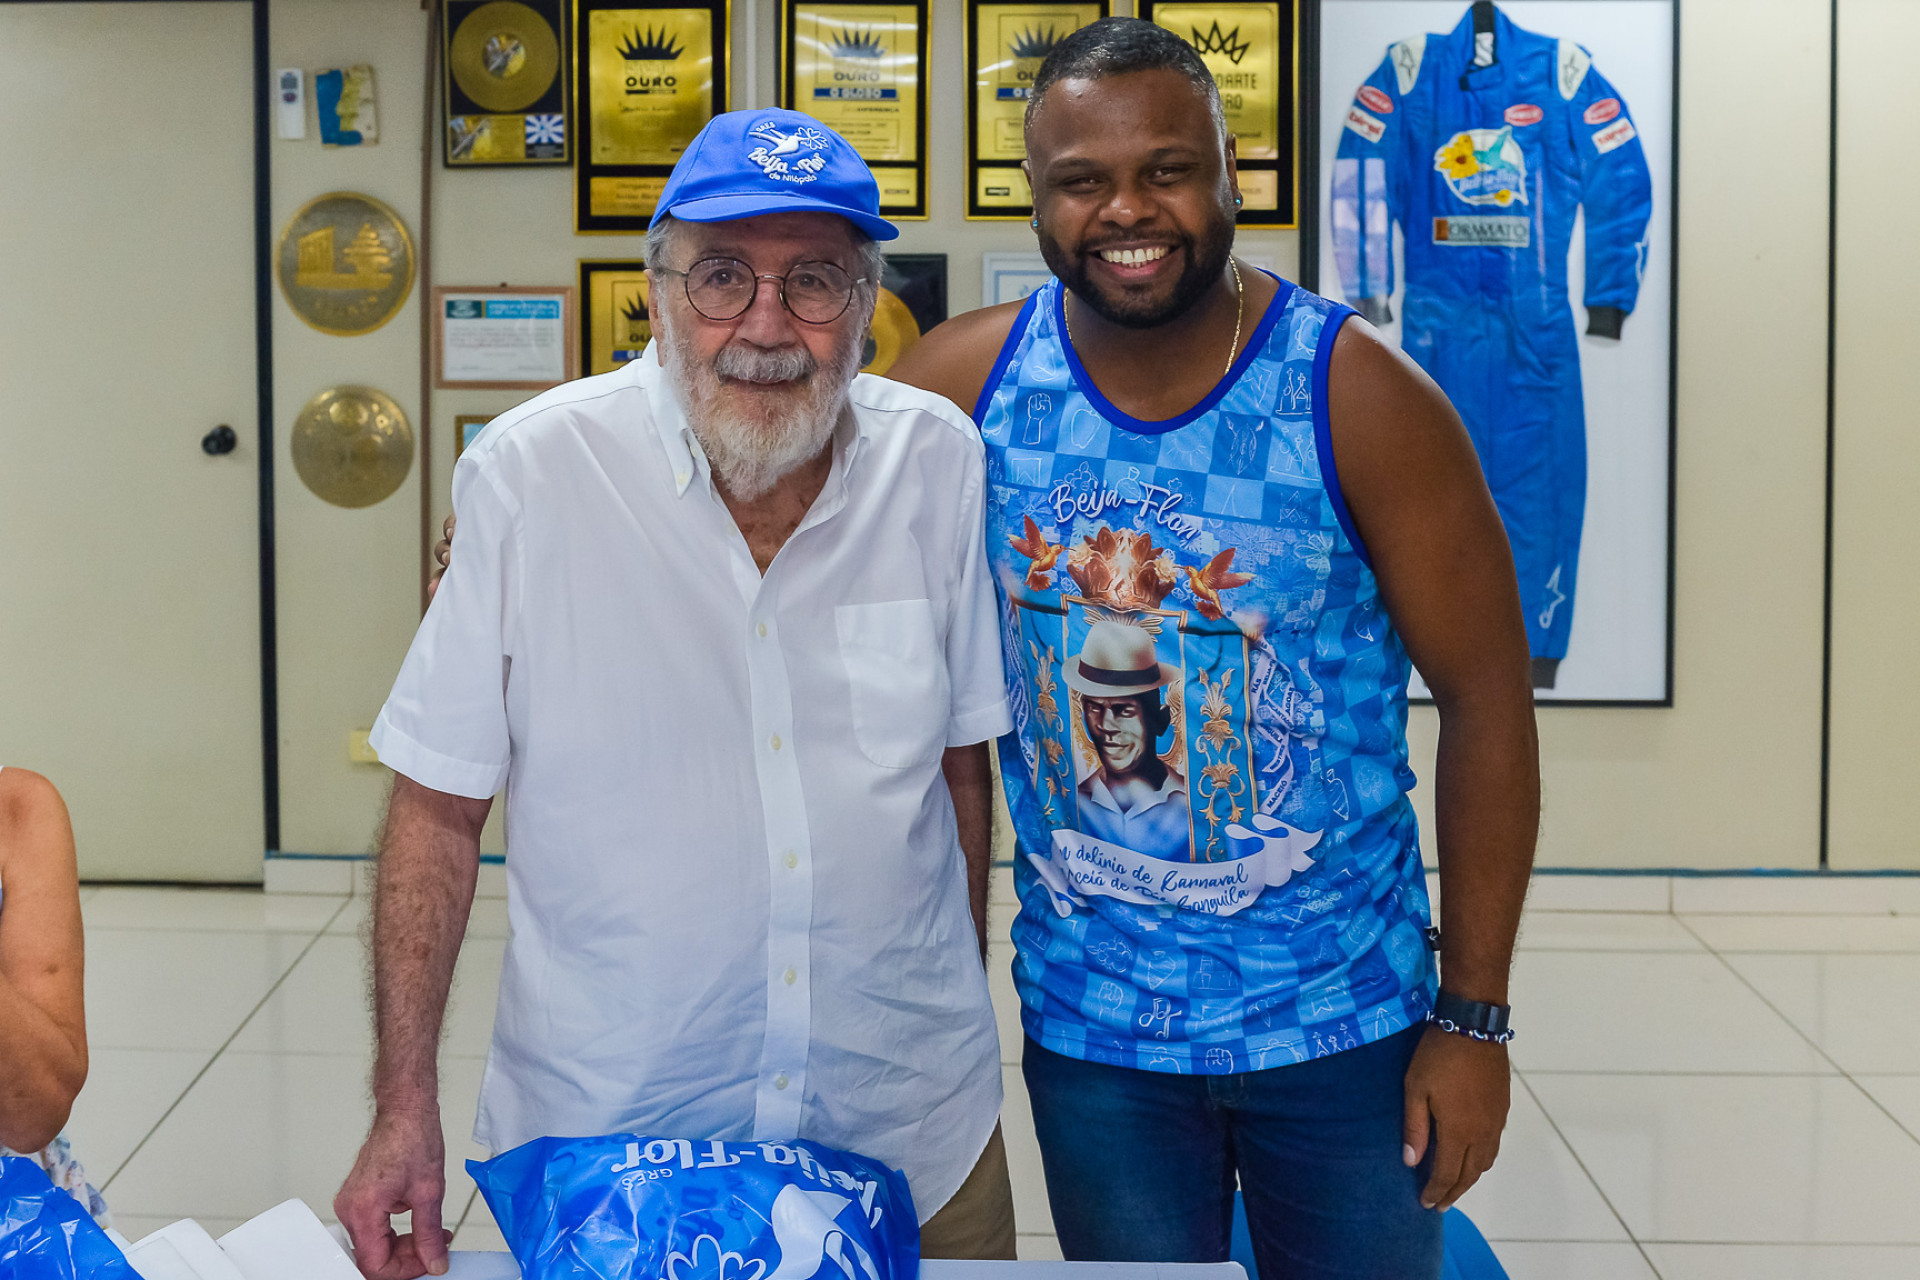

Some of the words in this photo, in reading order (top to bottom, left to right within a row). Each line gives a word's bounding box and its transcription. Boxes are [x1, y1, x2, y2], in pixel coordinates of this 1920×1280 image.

[626, 76, 676, 87] OURO
[834, 71, 880, 81] OURO
[1049, 480, 1200, 541] Beija-Flor
[1266, 780, 1288, 810] MACEIÓ
[1076, 844, 1127, 875] delírio
[1132, 865, 1154, 885] de
[1160, 862, 1249, 893] Carnaval
[1110, 877, 1130, 892] de
